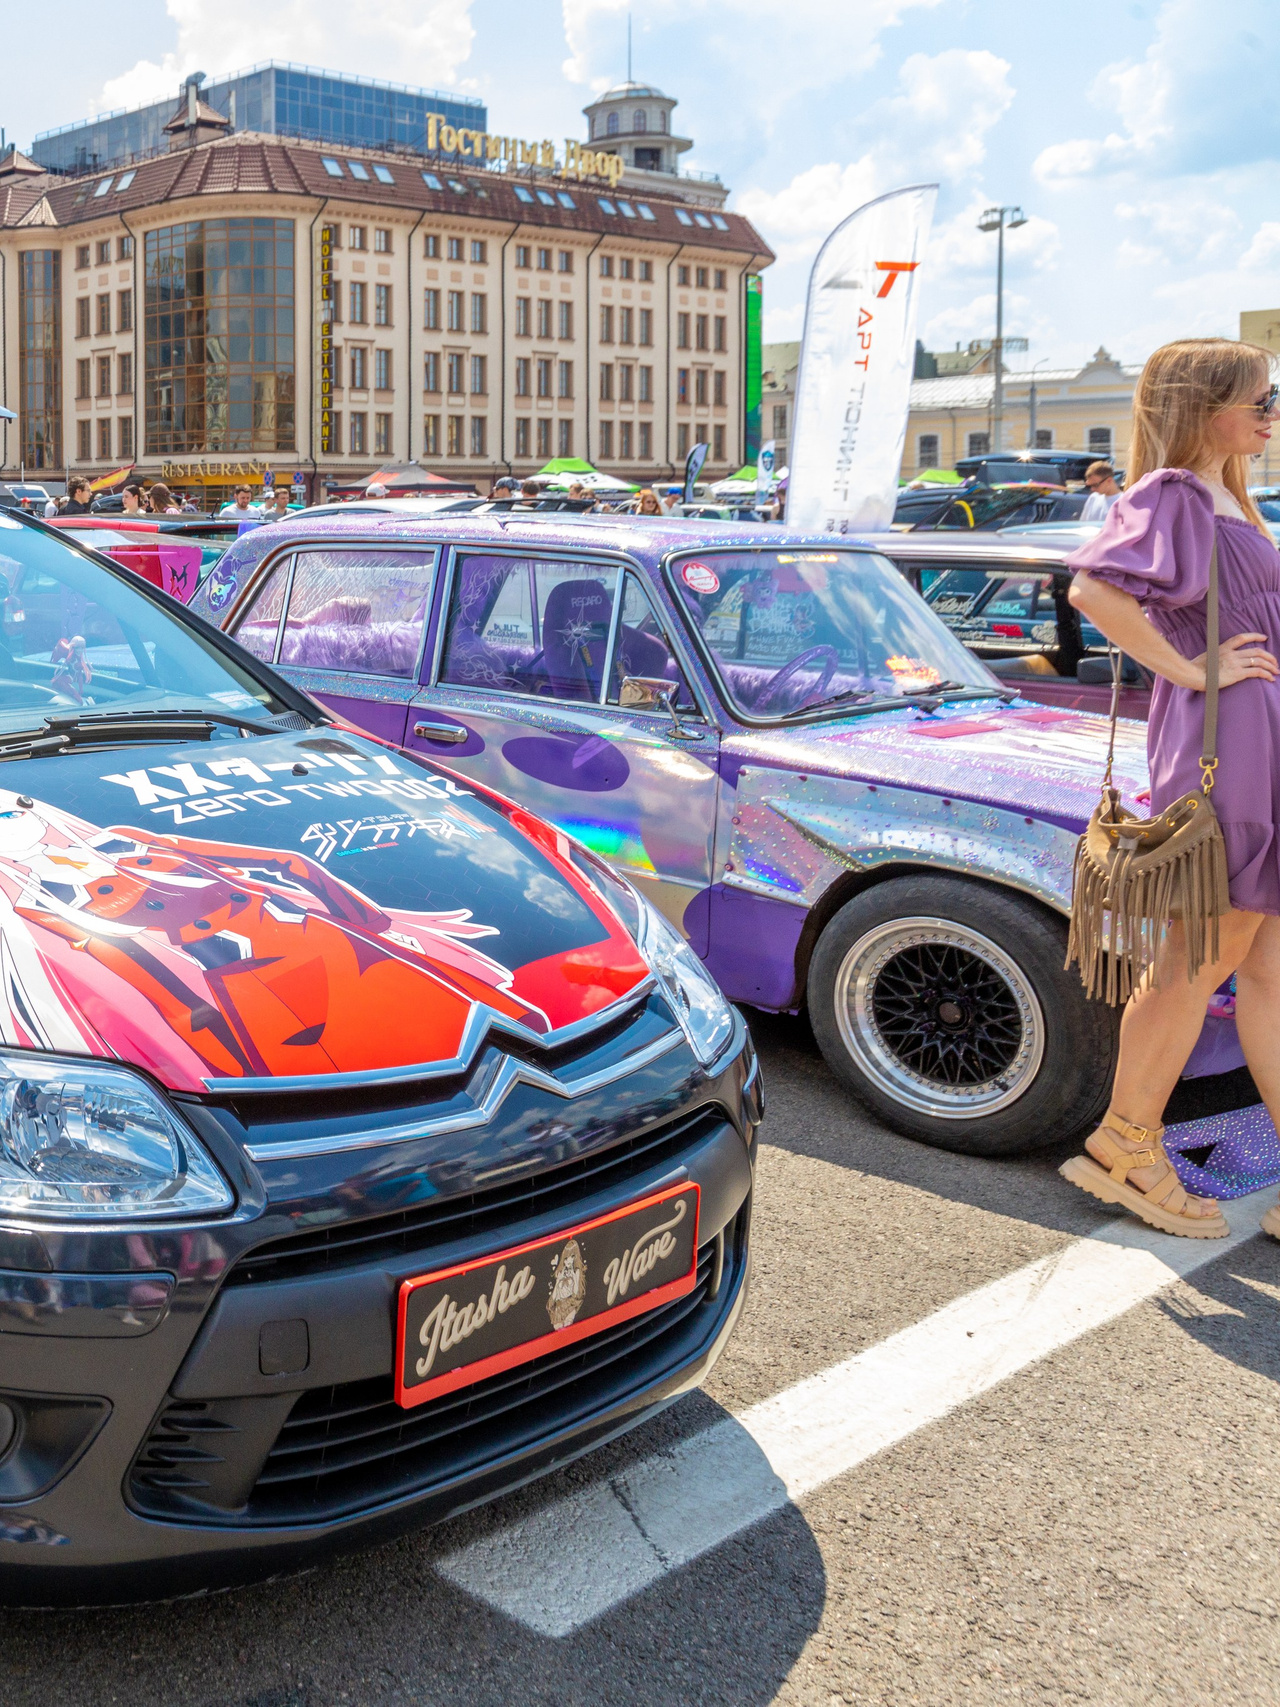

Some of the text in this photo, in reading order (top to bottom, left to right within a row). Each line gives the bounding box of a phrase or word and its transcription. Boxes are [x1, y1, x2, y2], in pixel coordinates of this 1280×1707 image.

[426, 112, 625, 188] Гостиный Двор
[322, 228, 331, 299] HOTEL
[833, 307, 873, 501] АРТ ТЮНИНГ
[161, 462, 271, 478] RESTAURANT
[571, 595, 603, 607] RECARO
[414, 1199, 687, 1378] Itasha Wave
